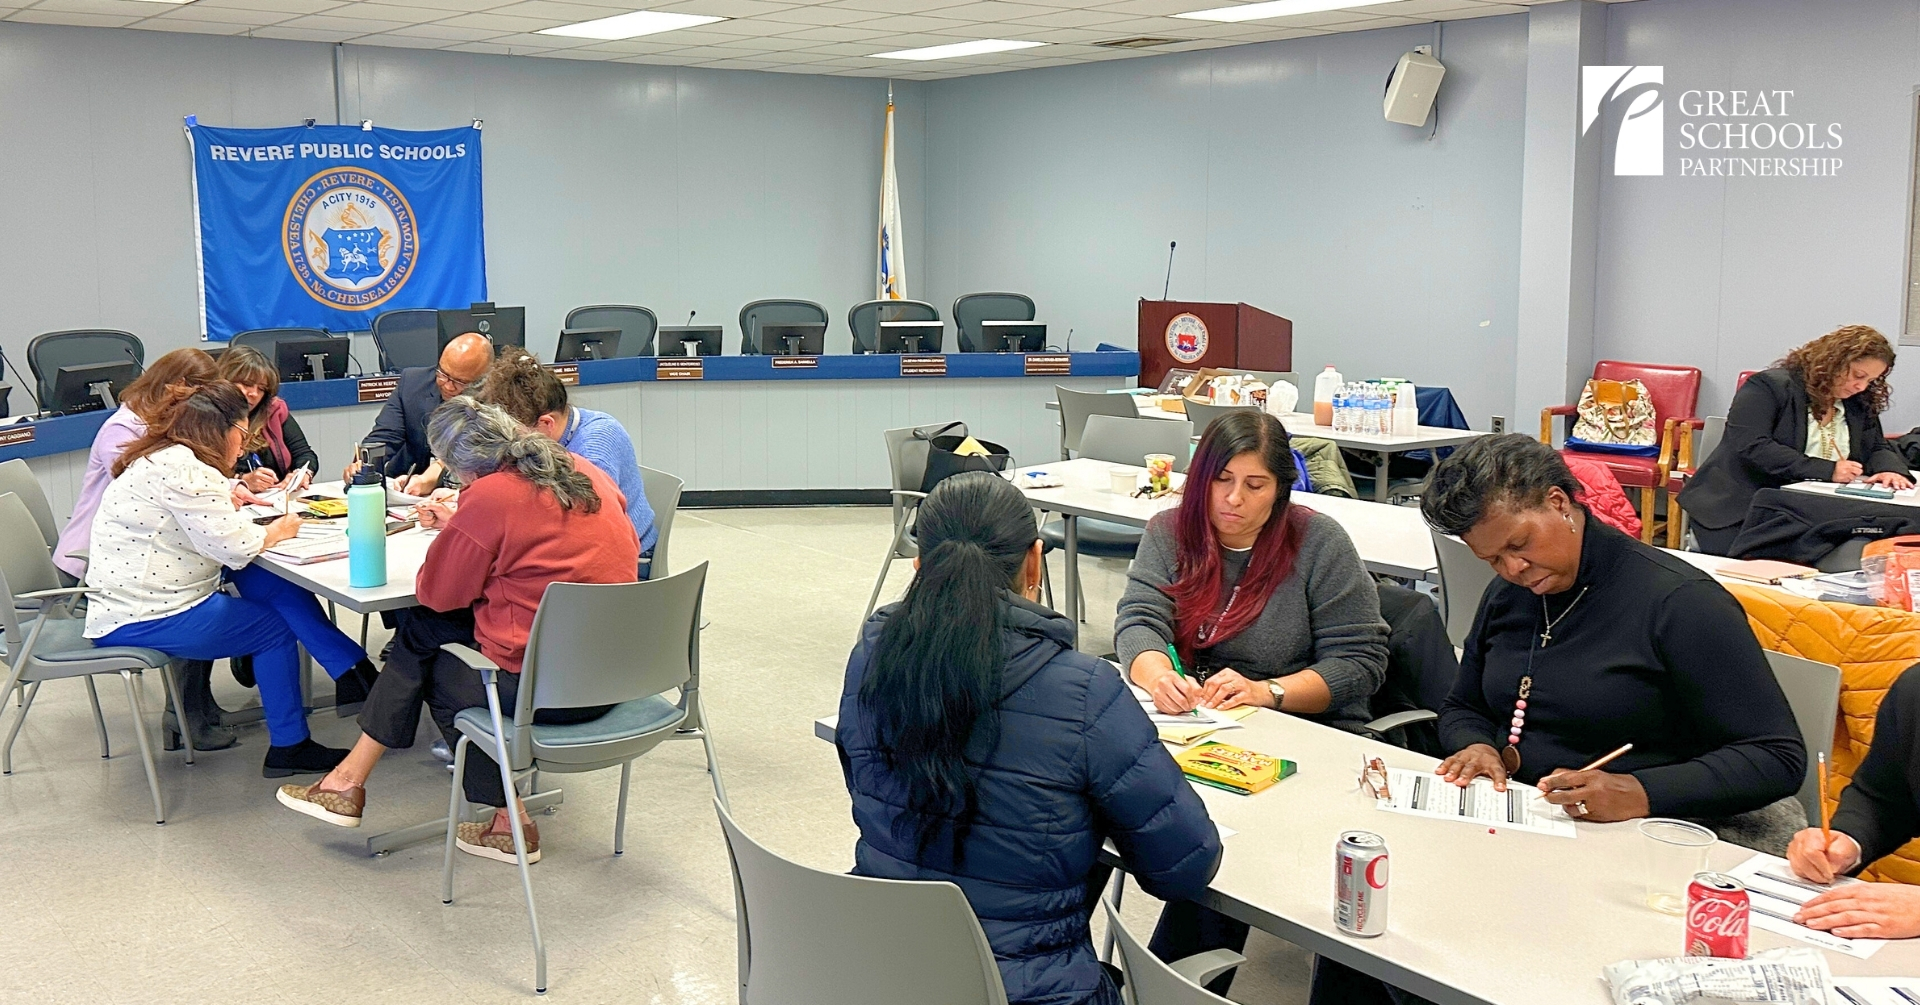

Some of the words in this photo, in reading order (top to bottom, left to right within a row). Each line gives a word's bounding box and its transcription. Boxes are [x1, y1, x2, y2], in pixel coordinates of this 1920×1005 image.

[210, 144, 294, 162] REVERE
[300, 143, 374, 159] PUBLIC
[379, 144, 466, 160] SCHOOLS
[320, 173, 376, 190] REVERE
[322, 200, 329, 210] A
[328, 193, 352, 204] CITY
[355, 194, 376, 209] 1915
[289, 188, 316, 249] CHELSEA
[292, 252, 310, 278] 1739
[327, 288, 386, 304] CHELSEA
[384, 267, 406, 290] 1846
[1358, 890, 1364, 902] ME
[1689, 898, 1748, 937] Cola
